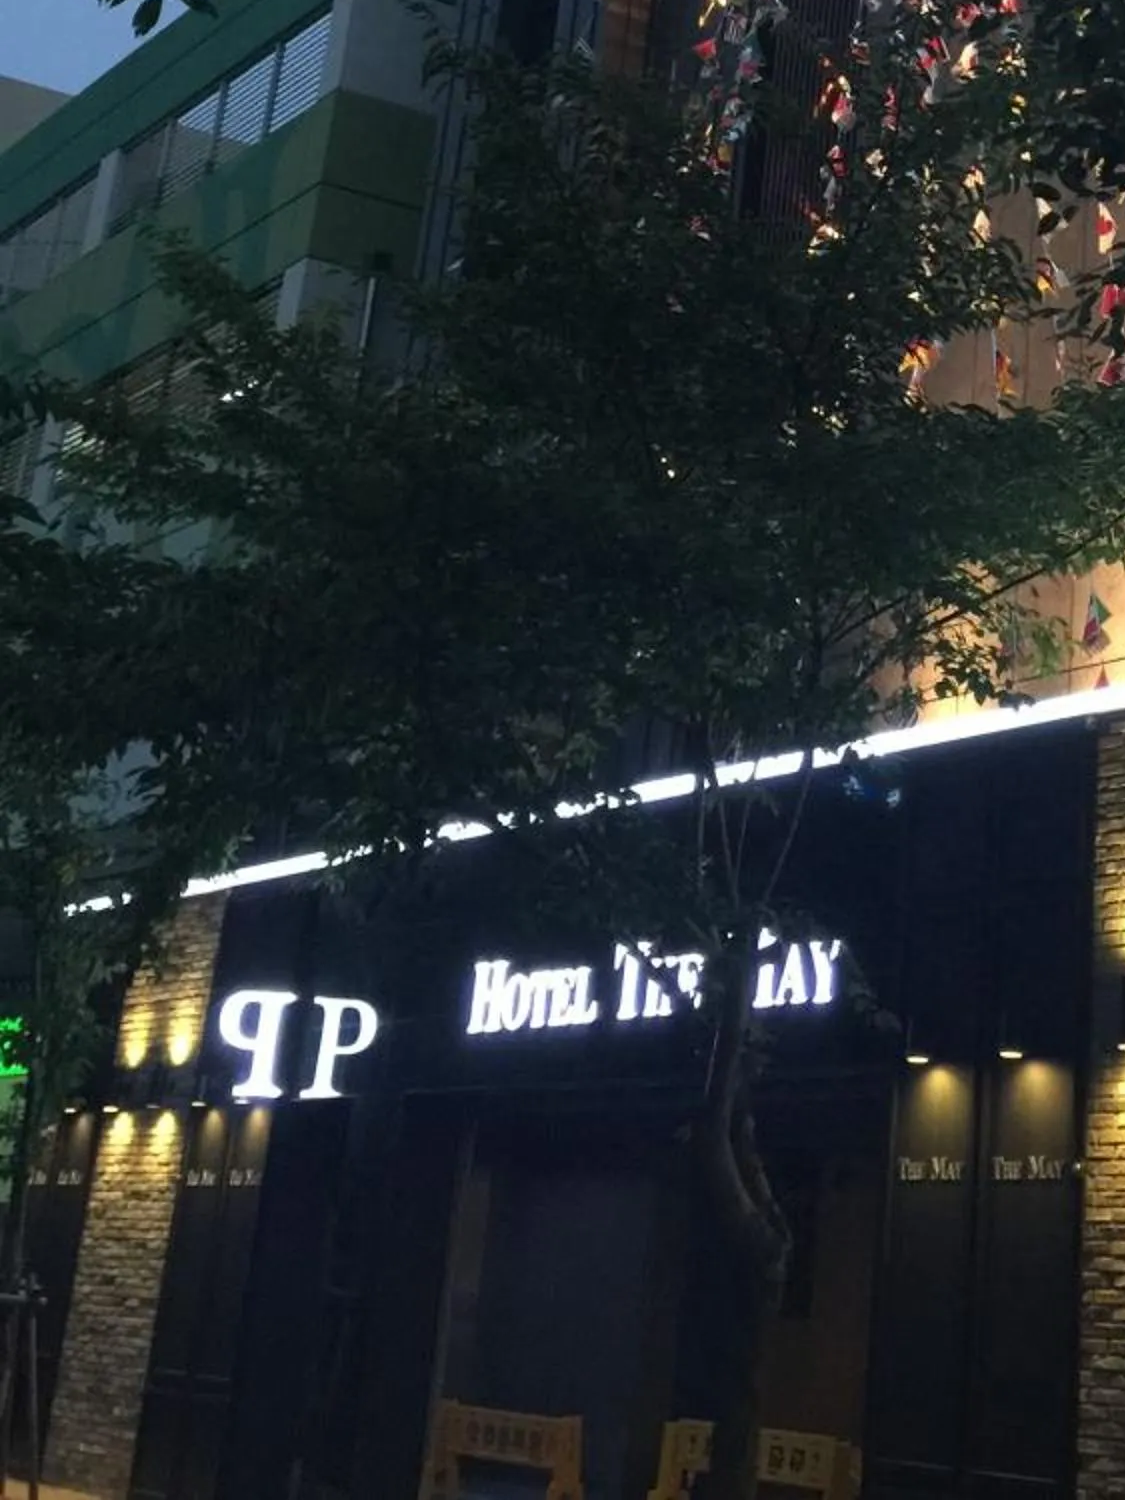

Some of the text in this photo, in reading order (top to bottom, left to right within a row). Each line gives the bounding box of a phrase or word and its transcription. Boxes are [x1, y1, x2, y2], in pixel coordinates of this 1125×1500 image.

[466, 959, 598, 1036] HOTEL
[929, 1155, 964, 1182] MAY
[992, 1154, 1065, 1182] THE MAY
